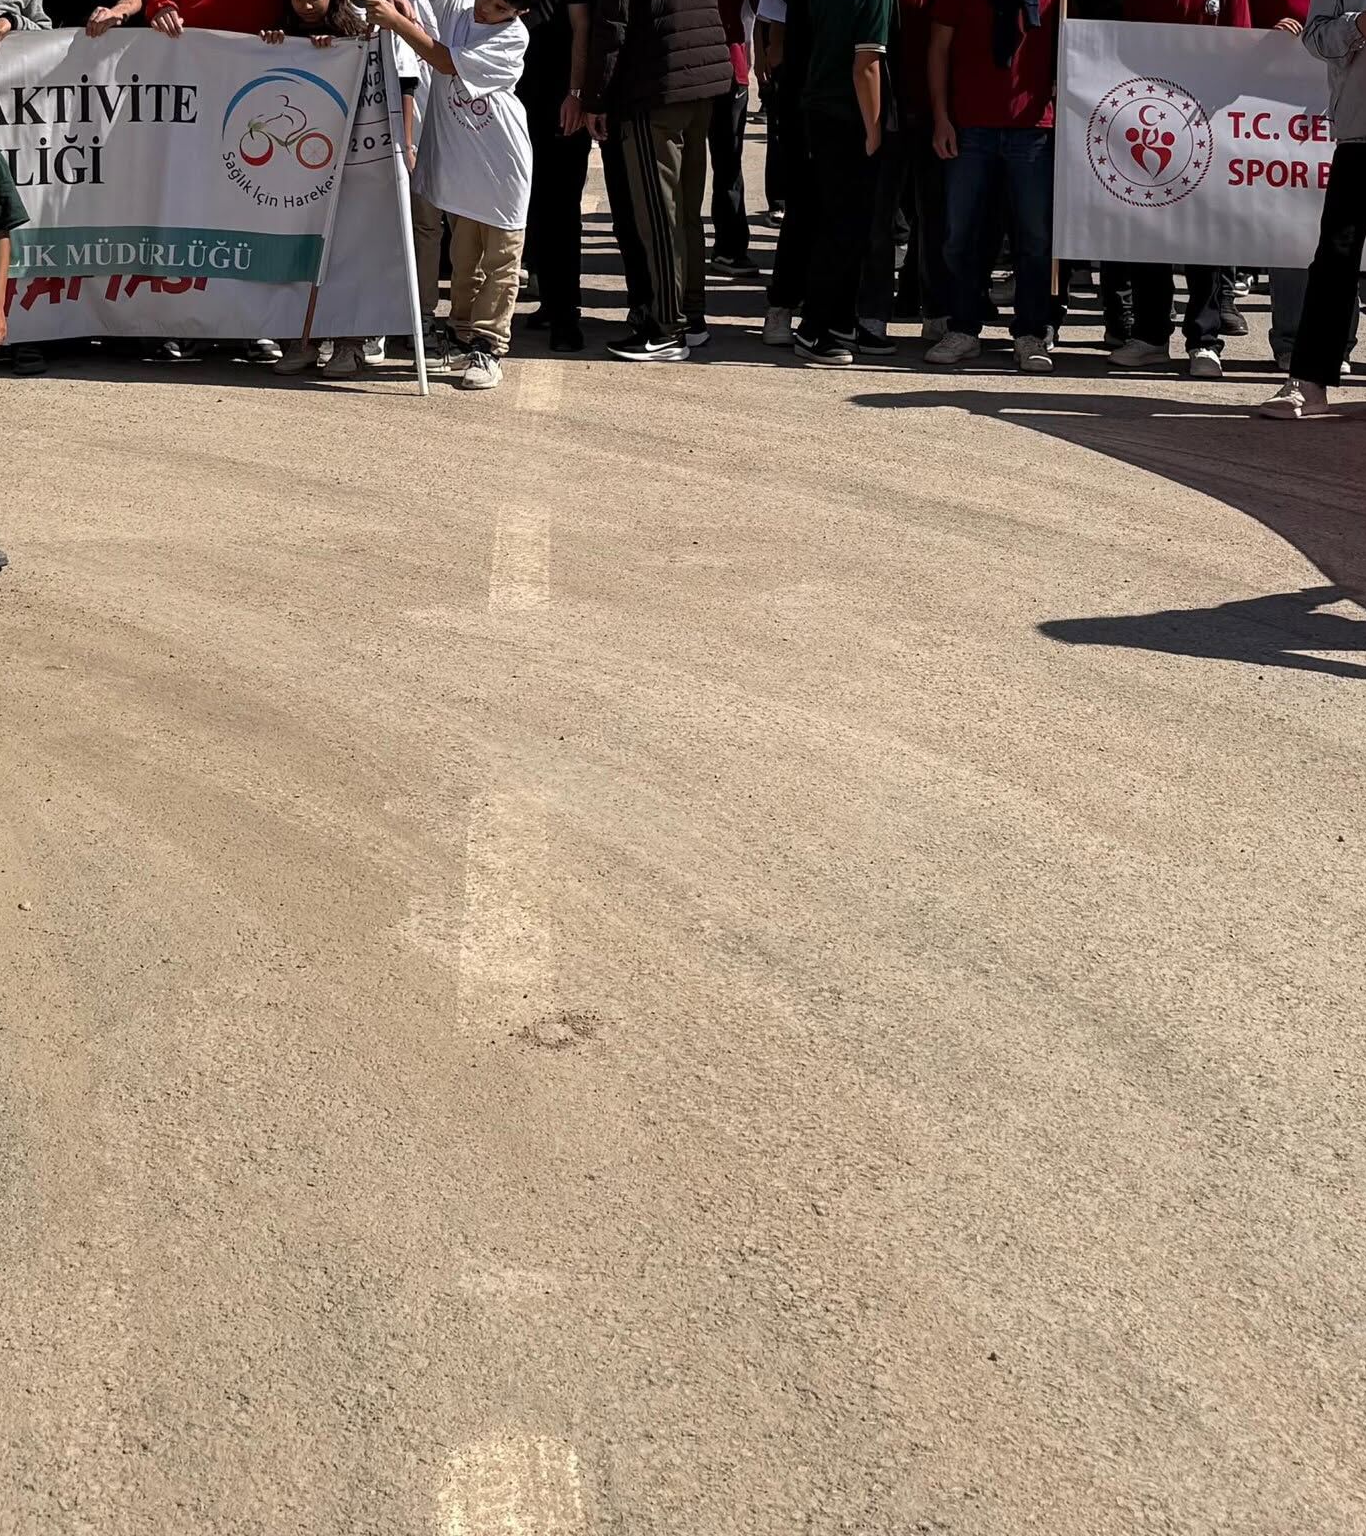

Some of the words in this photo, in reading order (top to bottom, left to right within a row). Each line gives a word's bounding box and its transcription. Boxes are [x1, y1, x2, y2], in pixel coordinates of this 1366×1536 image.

[1228, 112, 1280, 140] T.C.
[350, 133, 392, 153] 202
[222, 151, 255, 194] Sağlık
[1228, 158, 1309, 188] SPOR
[66, 237, 252, 270] MÜDÜRLÜĞÜ
